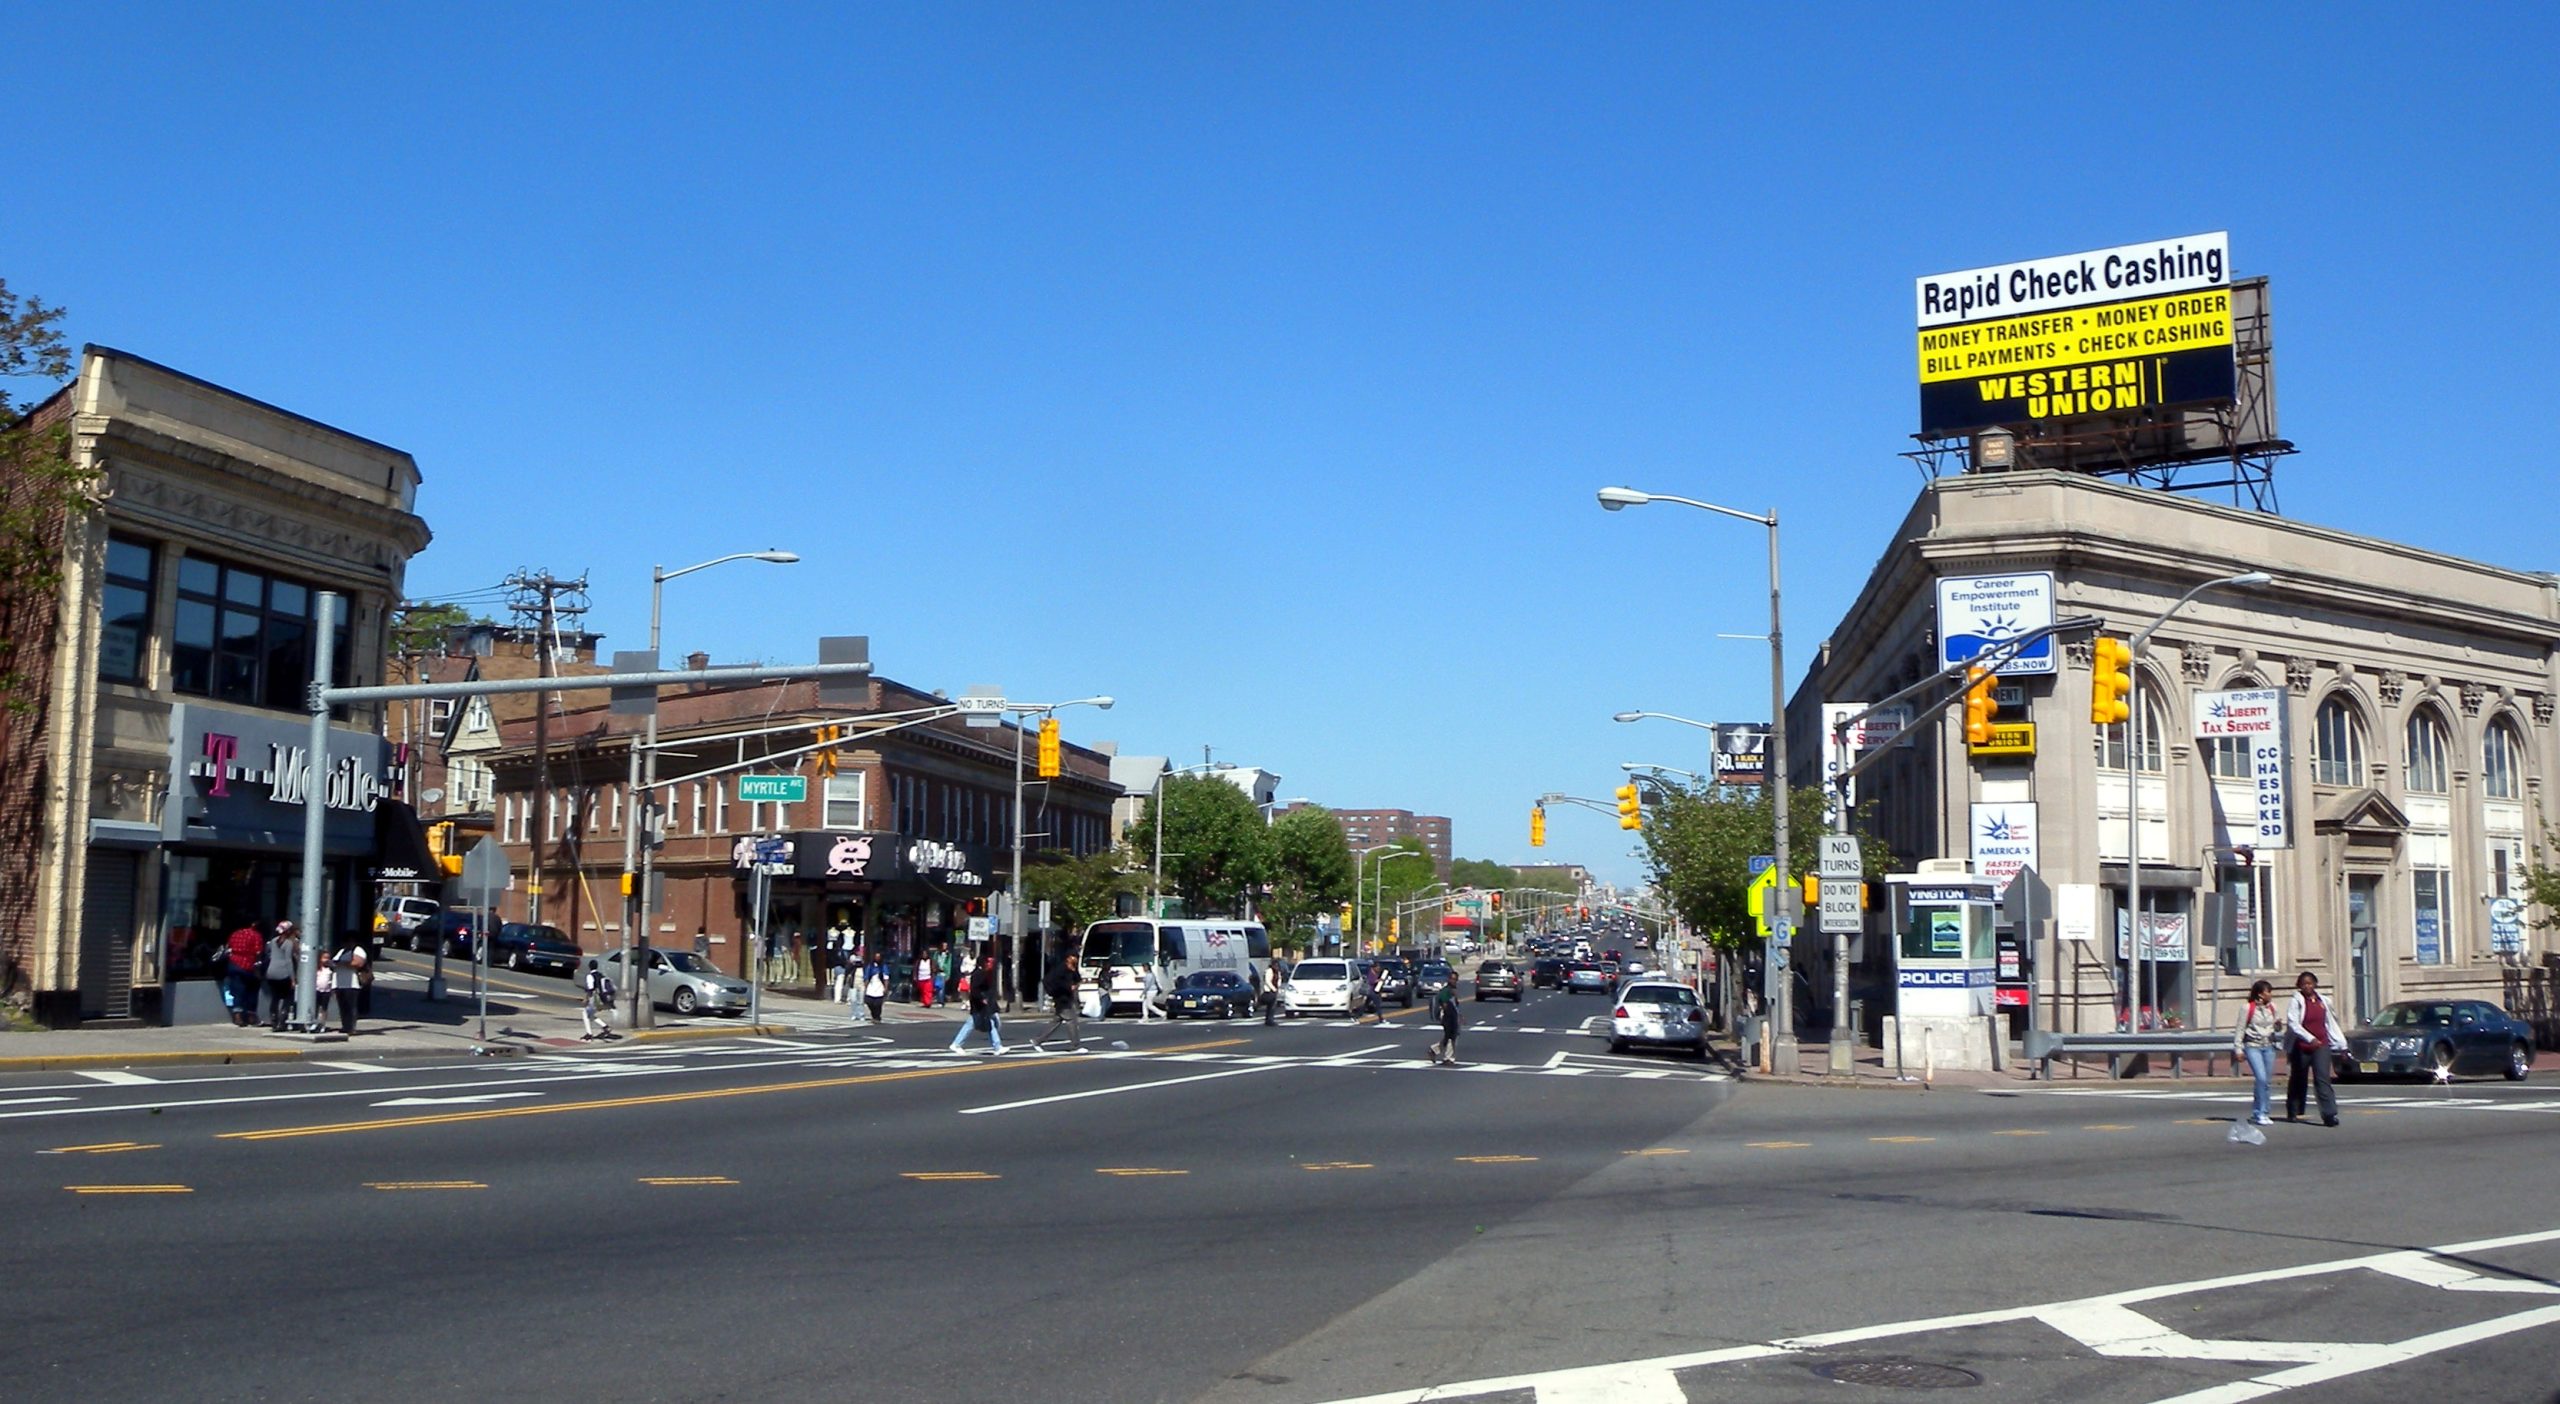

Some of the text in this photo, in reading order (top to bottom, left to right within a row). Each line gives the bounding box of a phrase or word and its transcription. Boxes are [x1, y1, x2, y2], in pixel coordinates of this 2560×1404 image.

[1924, 244, 2222, 319] Rapid Check Cashing
[1923, 295, 2226, 351] MONEY TRANSFER MONEY ORDER
[1927, 320, 2224, 374] BILL PAYMENTS CHECK CASHING
[1978, 361, 2137, 401] WESTERN
[2028, 385, 2138, 418] UNION
[1974, 580, 2015, 589] Career
[1951, 588, 2039, 601] Empowerment
[1970, 602, 2021, 612] Institute
[960, 700, 1006, 709] NO TURNS
[2226, 705, 2269, 717] LIBERTY
[2202, 720, 2271, 733] TAX SERVICE
[743, 779, 803, 795] MYRTLE AVE
[1832, 842, 1850, 853] NO
[1979, 847, 2031, 855] AMERICA'S
[1824, 860, 1859, 871] TURNS
[1985, 860, 2023, 868] FASTEST
[1824, 885, 1858, 896] DO NOT
[1909, 890, 1964, 899] VINGTON
[1825, 902, 1857, 912] BLOCK
[1776, 922, 1787, 940] G
[1899, 972, 1965, 984] POLICE
